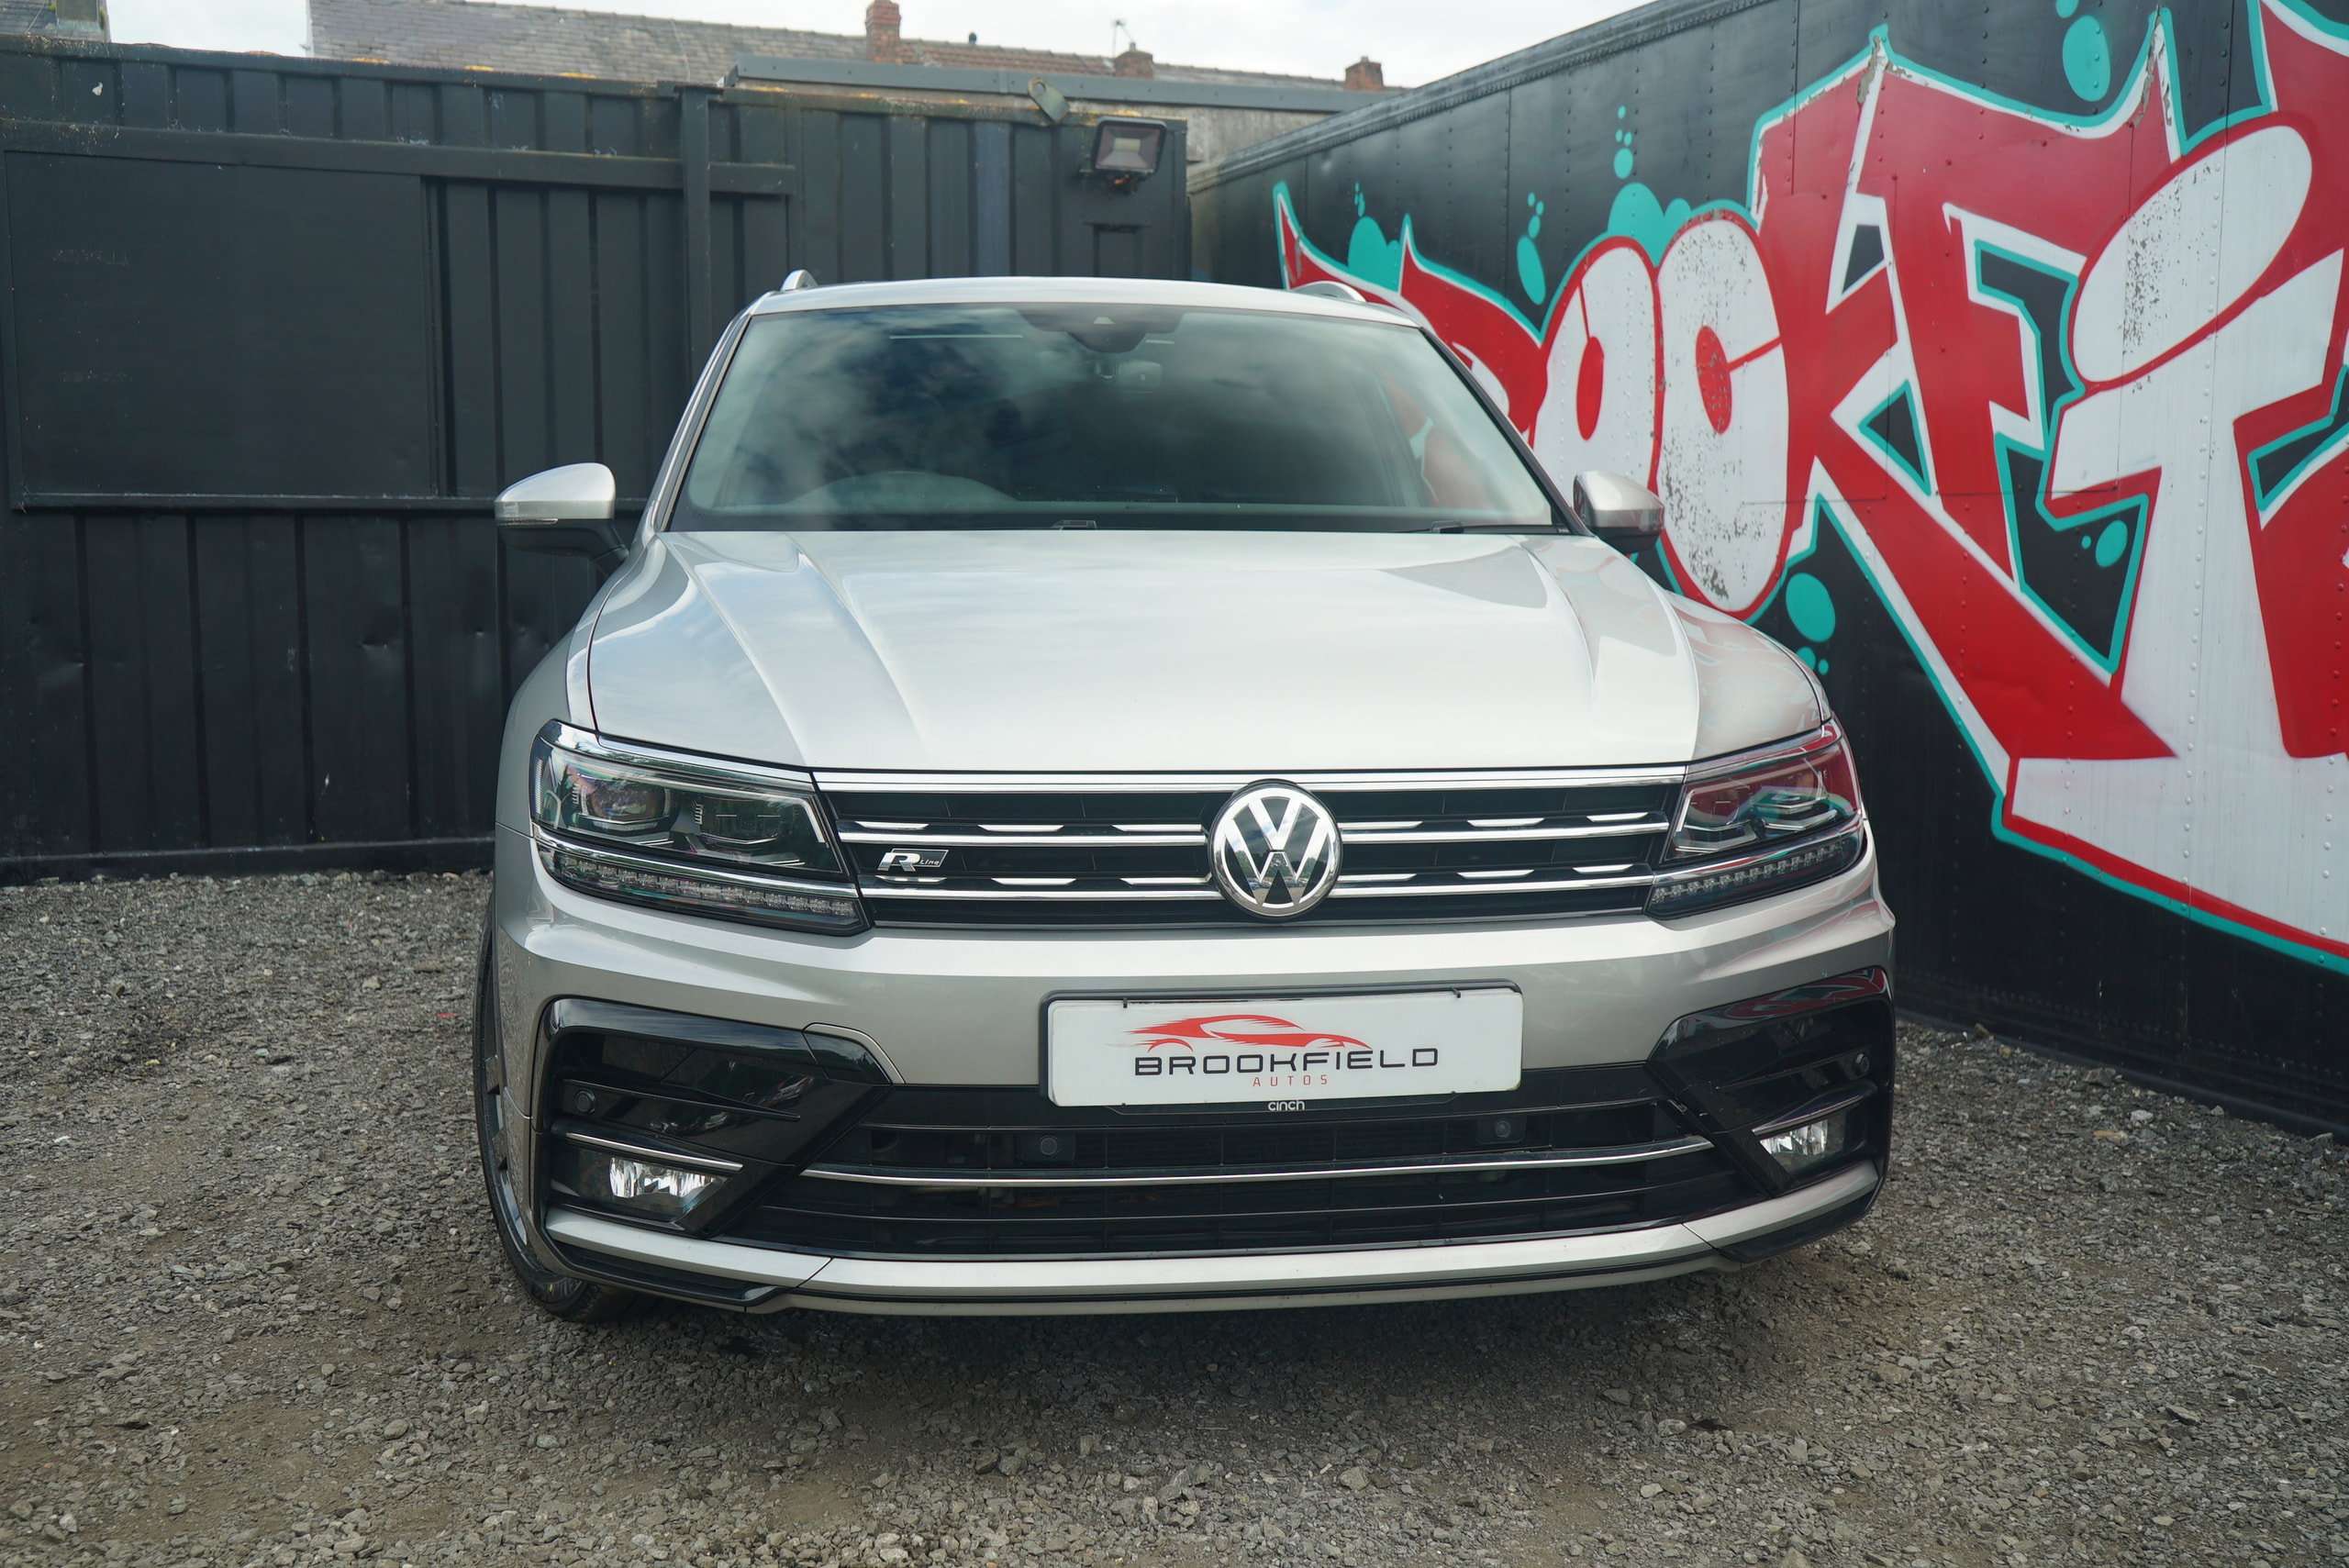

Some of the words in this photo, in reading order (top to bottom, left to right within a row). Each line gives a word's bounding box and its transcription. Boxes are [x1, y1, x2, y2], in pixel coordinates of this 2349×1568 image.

[1219, 789, 1335, 912] VW
[877, 852, 920, 872] R
[1134, 1048, 1439, 1076] BROOKFIELD
[1252, 1074, 1328, 1087] AUTOS
[1267, 1100, 1306, 1111] cinch
